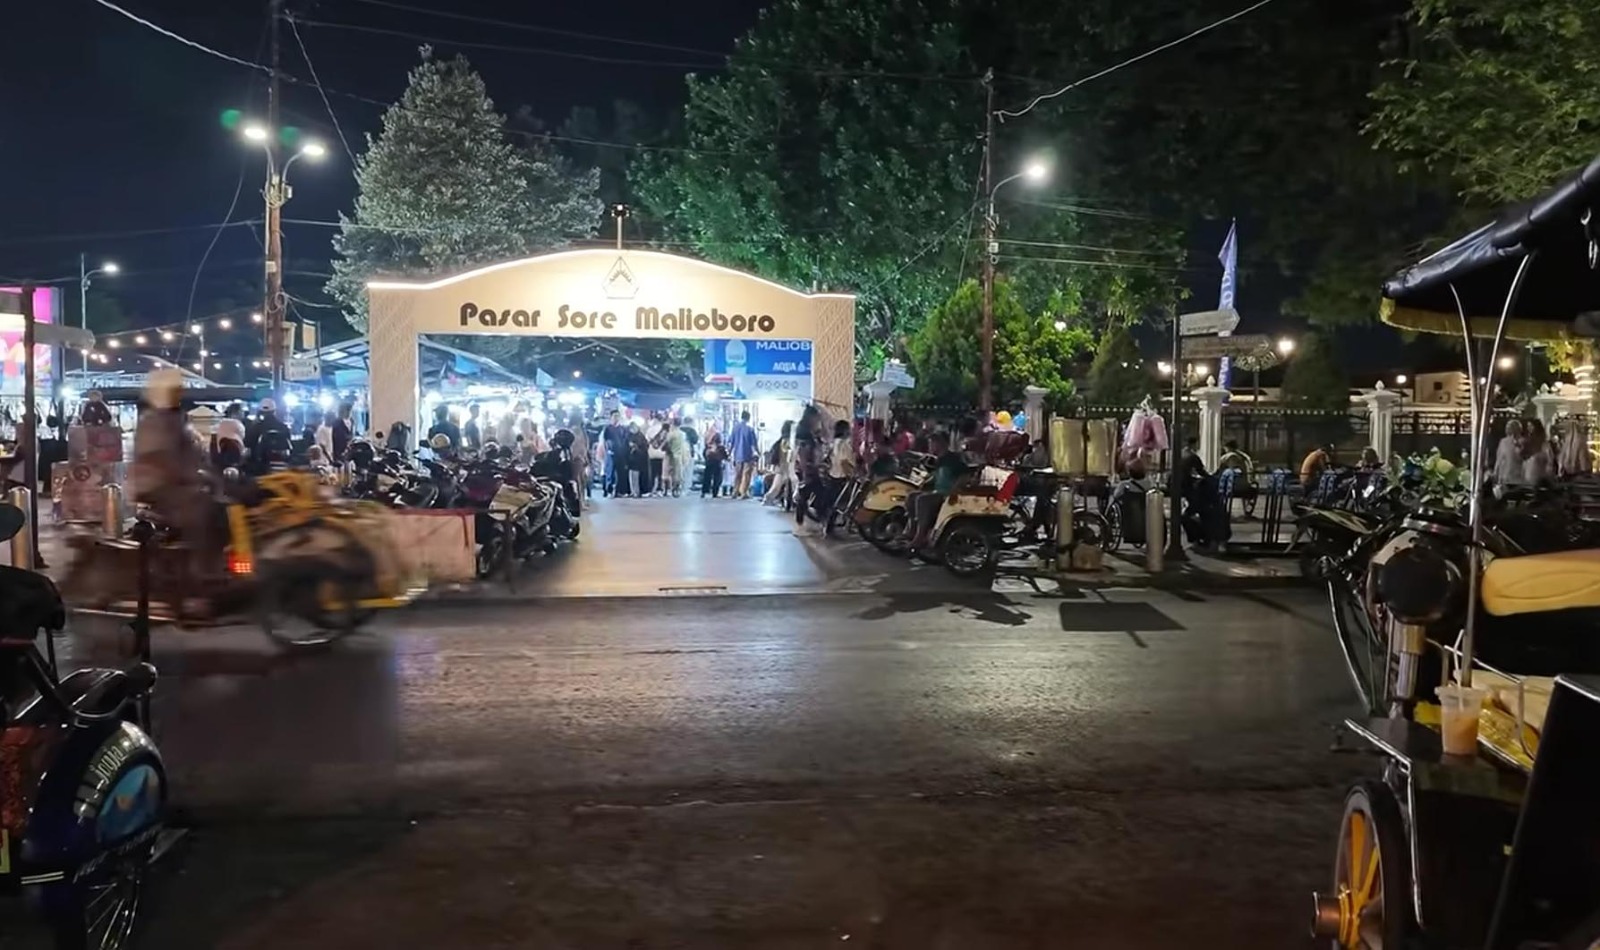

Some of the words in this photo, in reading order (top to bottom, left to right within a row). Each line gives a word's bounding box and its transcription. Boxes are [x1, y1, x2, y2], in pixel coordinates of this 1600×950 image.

[459, 302, 541, 328] Pasar
[557, 303, 618, 329] Sore
[635, 306, 776, 333] Malioboro
